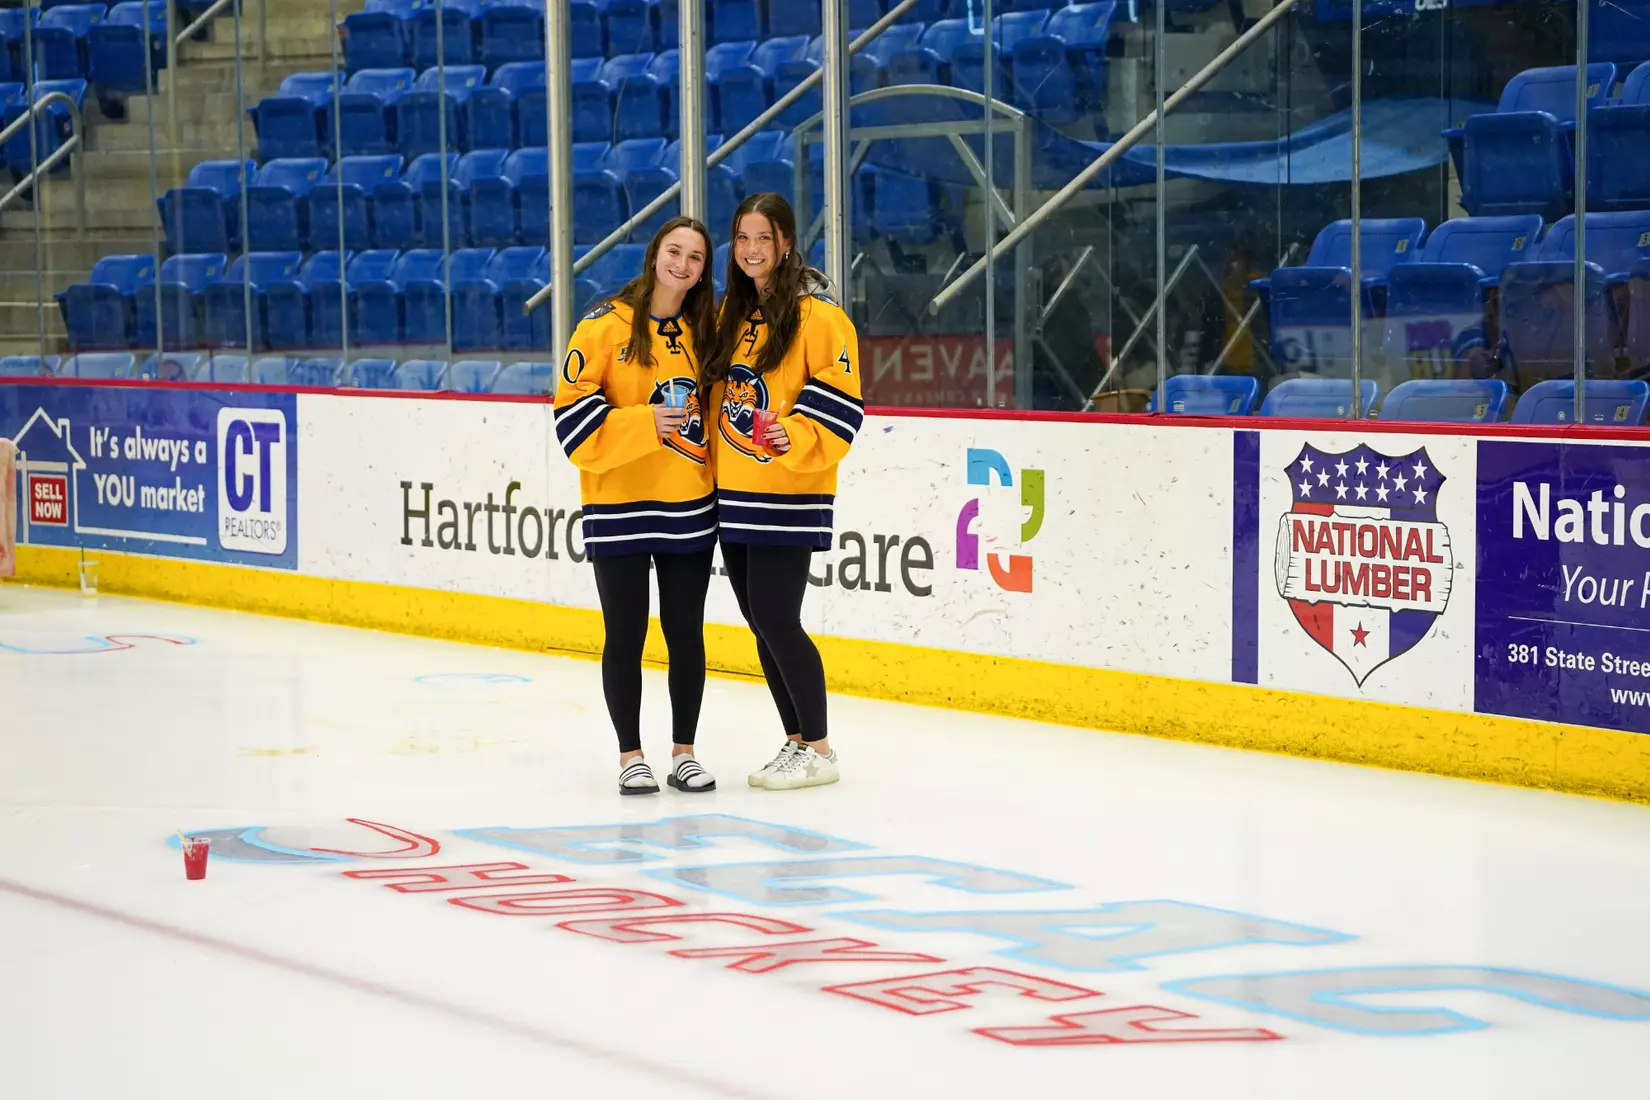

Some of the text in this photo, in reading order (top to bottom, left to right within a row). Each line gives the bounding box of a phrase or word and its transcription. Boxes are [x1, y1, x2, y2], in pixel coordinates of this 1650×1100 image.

[561, 347, 586, 385] 0
[836, 344, 852, 374] 4
[90, 425, 207, 472] It's always a
[225, 419, 280, 513] CT
[34, 482, 63, 501] SELL
[35, 501, 62, 519] NOW
[94, 474, 206, 513] YOU market
[1292, 519, 1444, 564] NATIONAL
[1305, 557, 1432, 602] LUMBER
[1561, 564, 1634, 607] Your
[1507, 643, 1539, 666] 381
[1545, 645, 1595, 672] State
[1610, 688, 1650, 707] ww
[341, 861, 1287, 1046] HOCKEY
